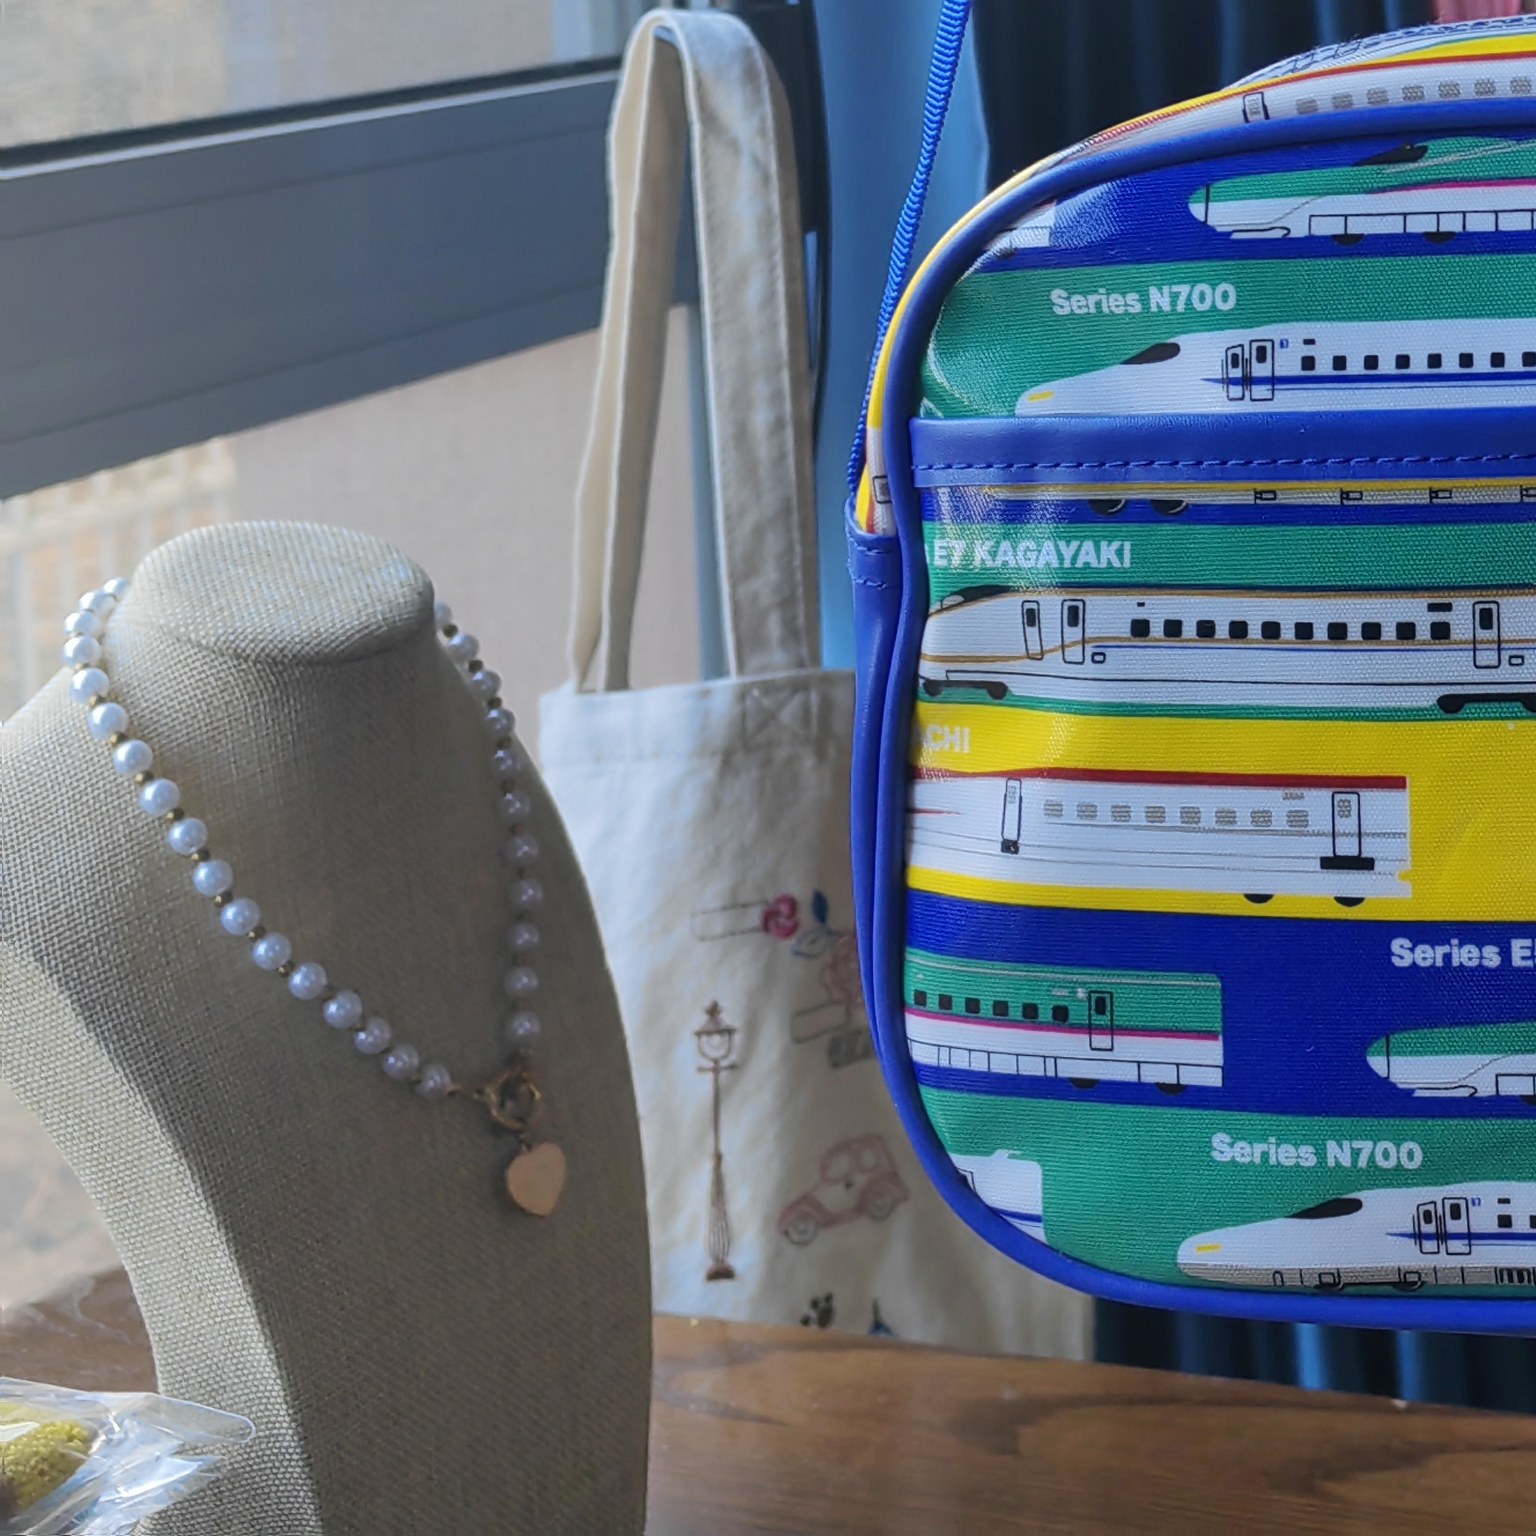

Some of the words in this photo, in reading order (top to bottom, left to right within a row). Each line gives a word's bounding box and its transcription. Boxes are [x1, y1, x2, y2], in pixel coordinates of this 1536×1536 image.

[1050, 287, 1143, 315] Series
[1149, 282, 1236, 312] N700
[933, 539, 965, 568] E7
[974, 540, 1132, 568] KAGAYAKI
[1390, 937, 1502, 969] Series
[1211, 1132, 1318, 1167] Series
[1326, 1140, 1423, 1170] N700
